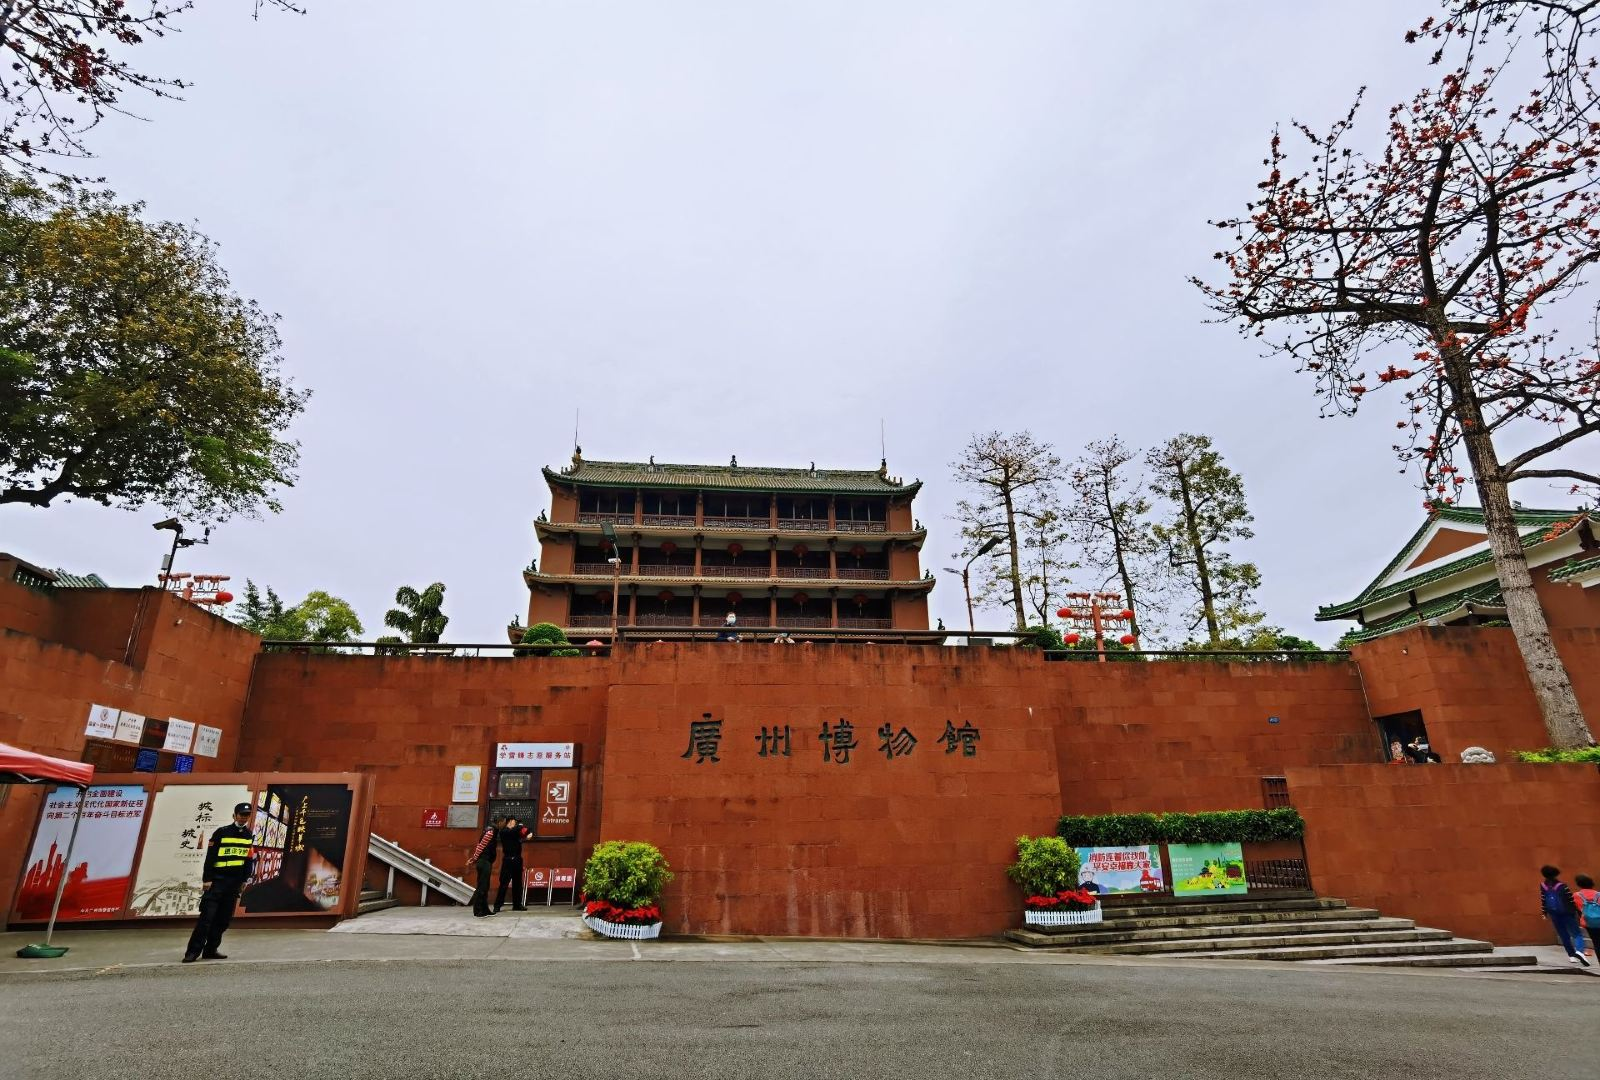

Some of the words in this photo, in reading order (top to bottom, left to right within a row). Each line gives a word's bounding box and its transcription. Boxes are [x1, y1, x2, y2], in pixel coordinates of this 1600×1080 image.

[680, 712, 980, 764] 廣州博物館
[500, 751, 571, 759] 学雷锋志愿服务站
[543, 806, 568, 817] 入口
